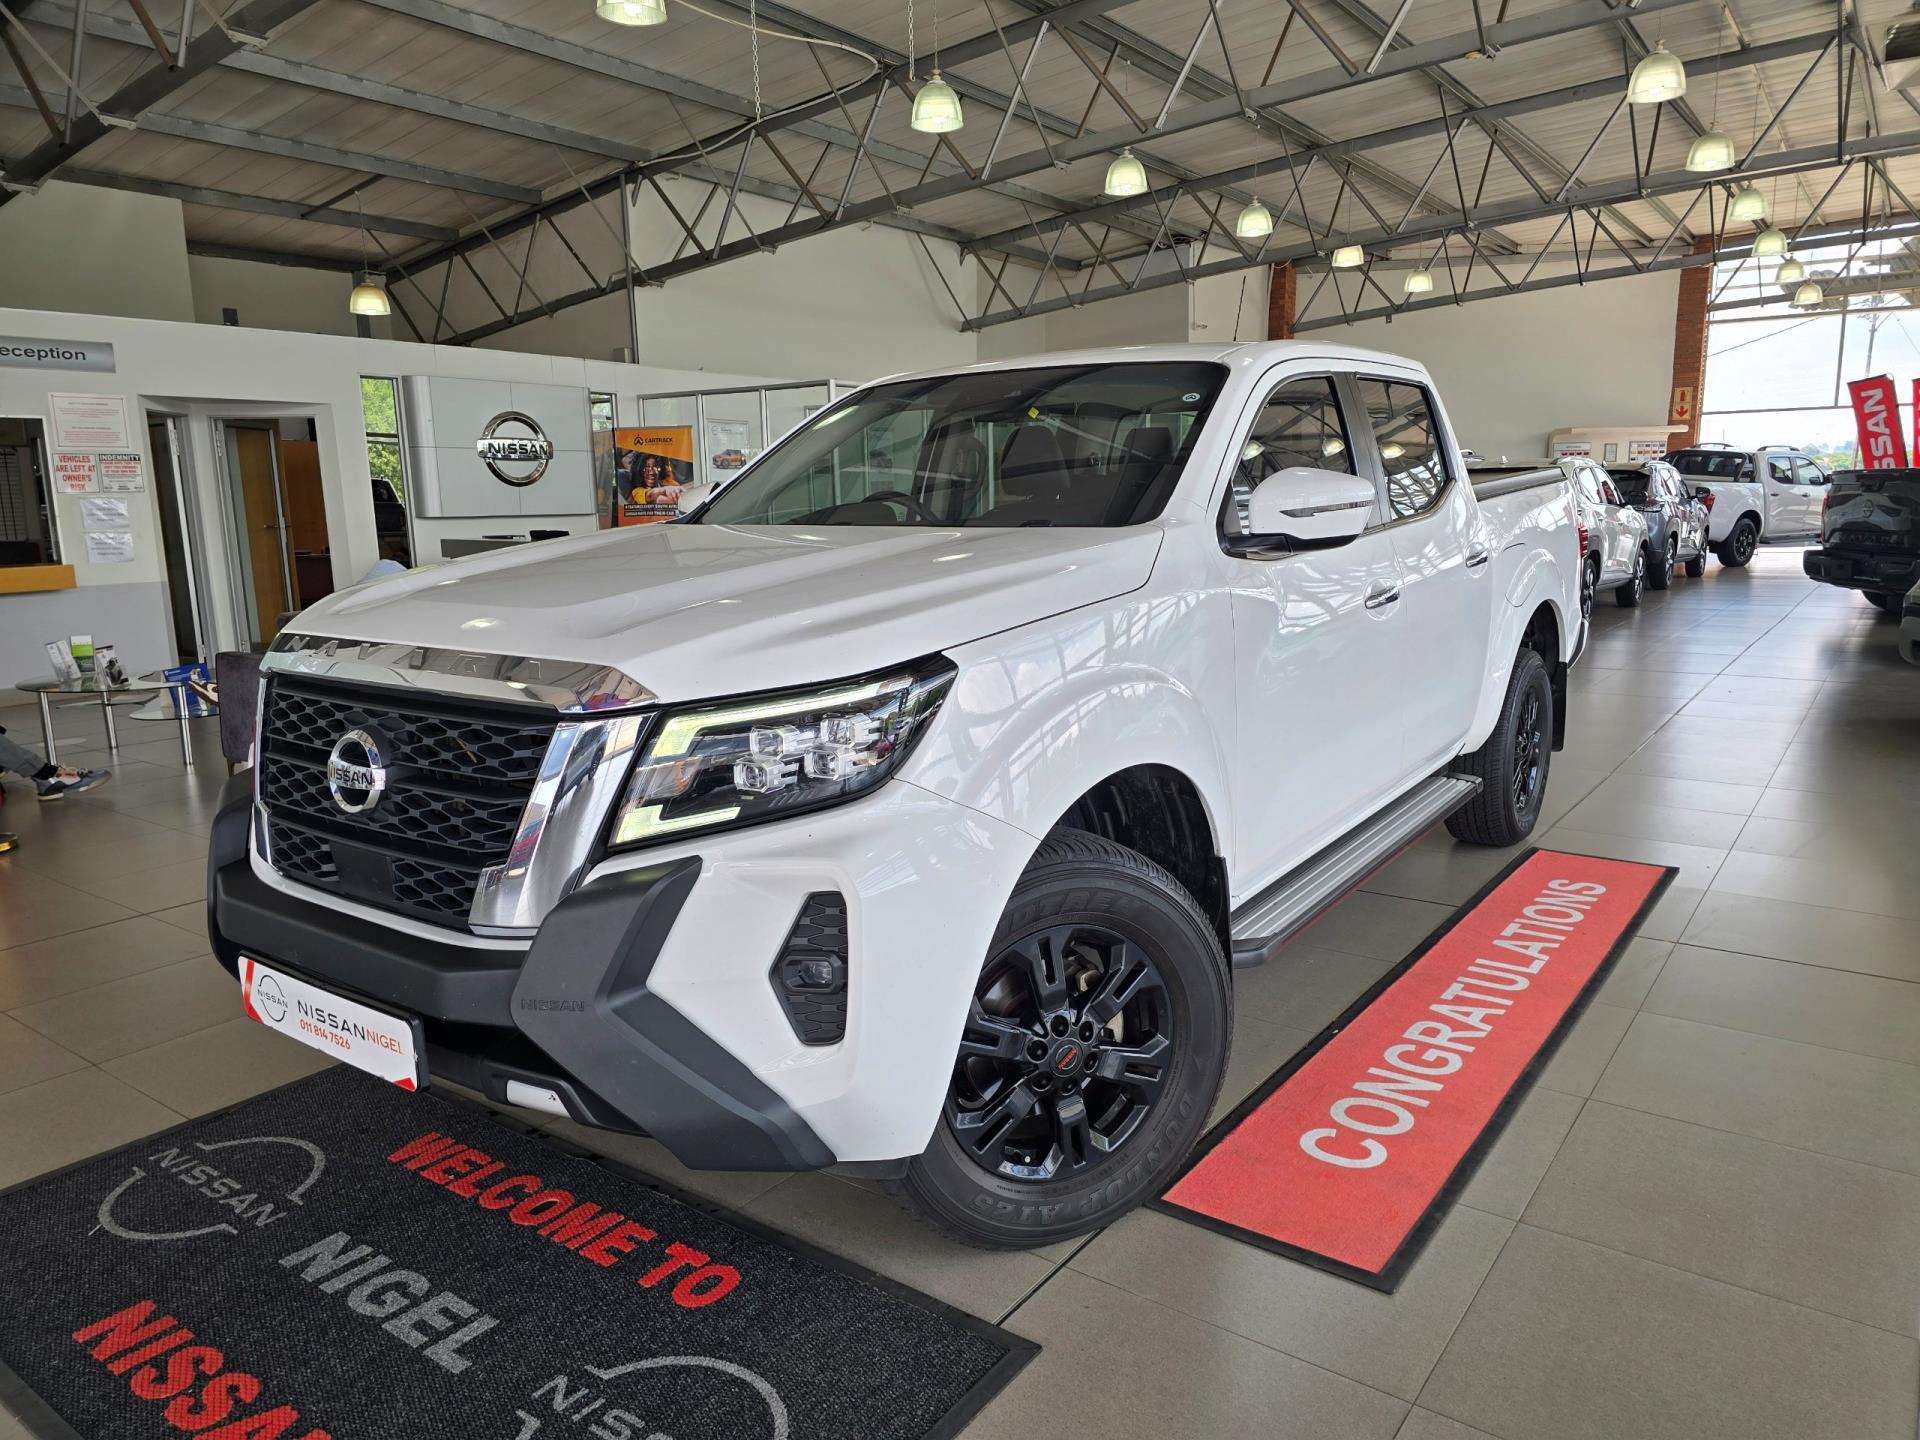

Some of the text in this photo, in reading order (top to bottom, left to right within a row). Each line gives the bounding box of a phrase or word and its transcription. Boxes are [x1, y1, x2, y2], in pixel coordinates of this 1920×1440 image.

[0, 346, 86, 361] eception
[1861, 388, 1896, 468] SSAN
[58, 455, 90, 463] VEHICLES
[488, 442, 547, 456] NISSAN
[56, 465, 96, 473] ARE LEFT AT
[328, 762, 373, 786] NISSAN
[257, 989, 288, 1008] NISSAN
[520, 999, 585, 1012] NISSAN
[299, 1019, 313, 1034] 011
[313, 1025, 329, 1041] 814
[1299, 879, 1606, 1169] CONGRATULATIONS
[148, 1147, 288, 1228] NISSAN
[387, 1131, 742, 1309] WELCOME TO
[278, 1231, 500, 1375] NIGEL
[71, 1299, 332, 1440] NISSA
[531, 1374, 675, 1440] NIS
